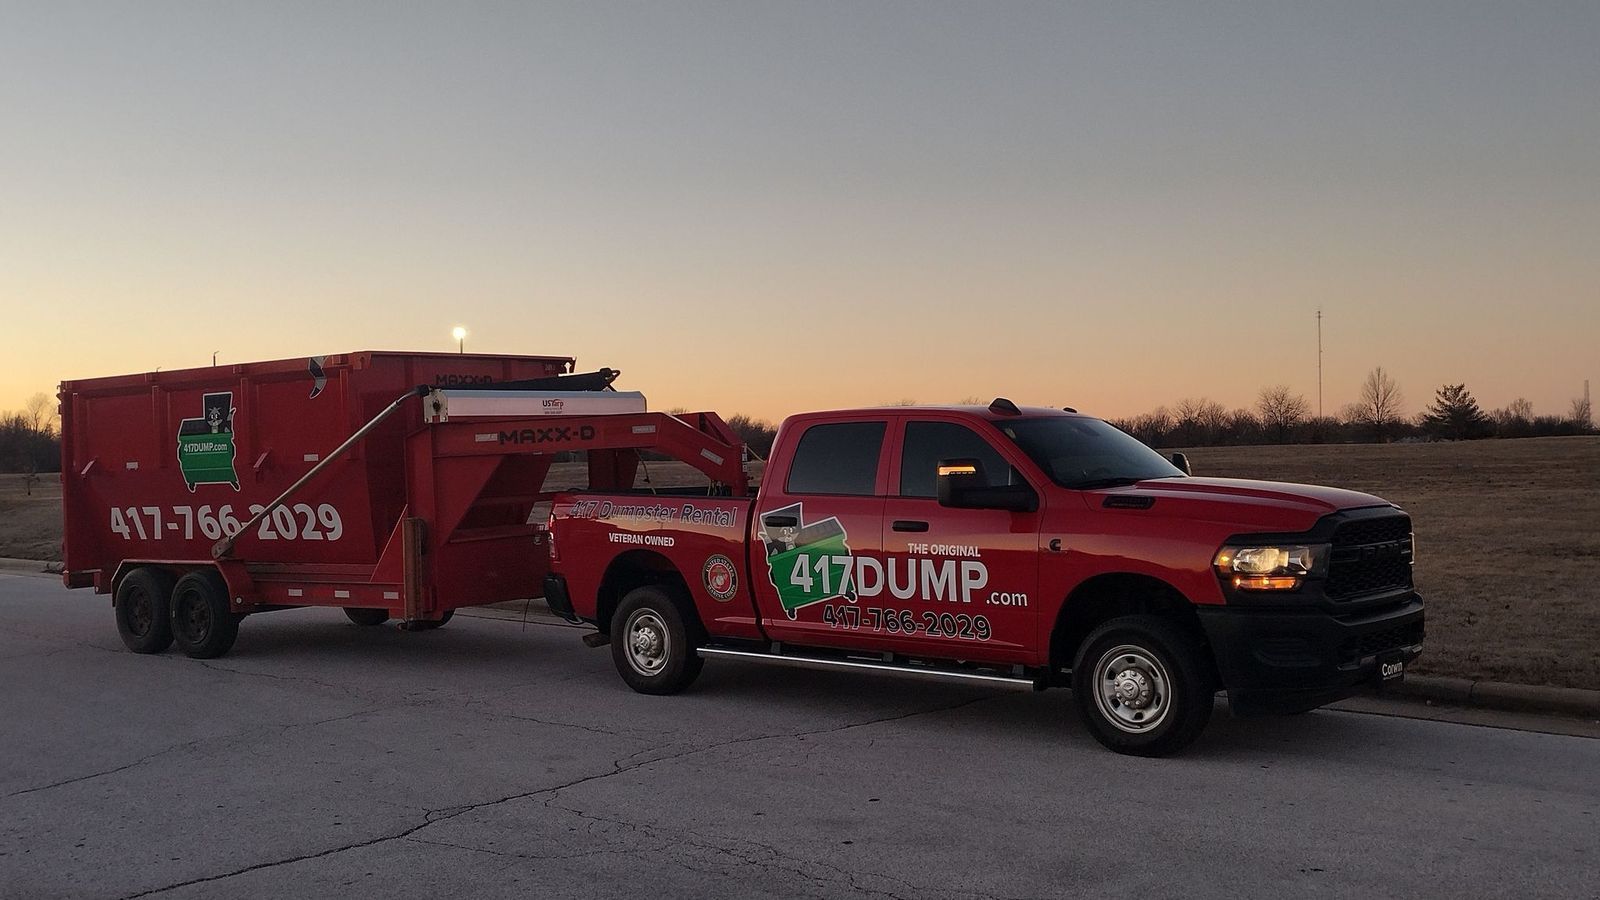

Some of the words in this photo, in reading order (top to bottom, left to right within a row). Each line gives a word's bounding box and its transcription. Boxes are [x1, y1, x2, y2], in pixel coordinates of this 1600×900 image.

[499, 426, 595, 444] MAXX-D
[183, 442, 228, 454] 417DUMP.com
[110, 502, 343, 541] 417-766-2029
[571, 501, 598, 518] 417
[599, 501, 676, 525] Dumpster
[680, 504, 737, 527] Rental
[608, 533, 644, 545] VETERAN
[644, 535, 675, 547] OWNED
[908, 543, 929, 555] THE
[931, 543, 981, 557] ORIGINAL
[822, 604, 992, 641] 417-766-2029
[1381, 661, 1402, 676] Corwin
